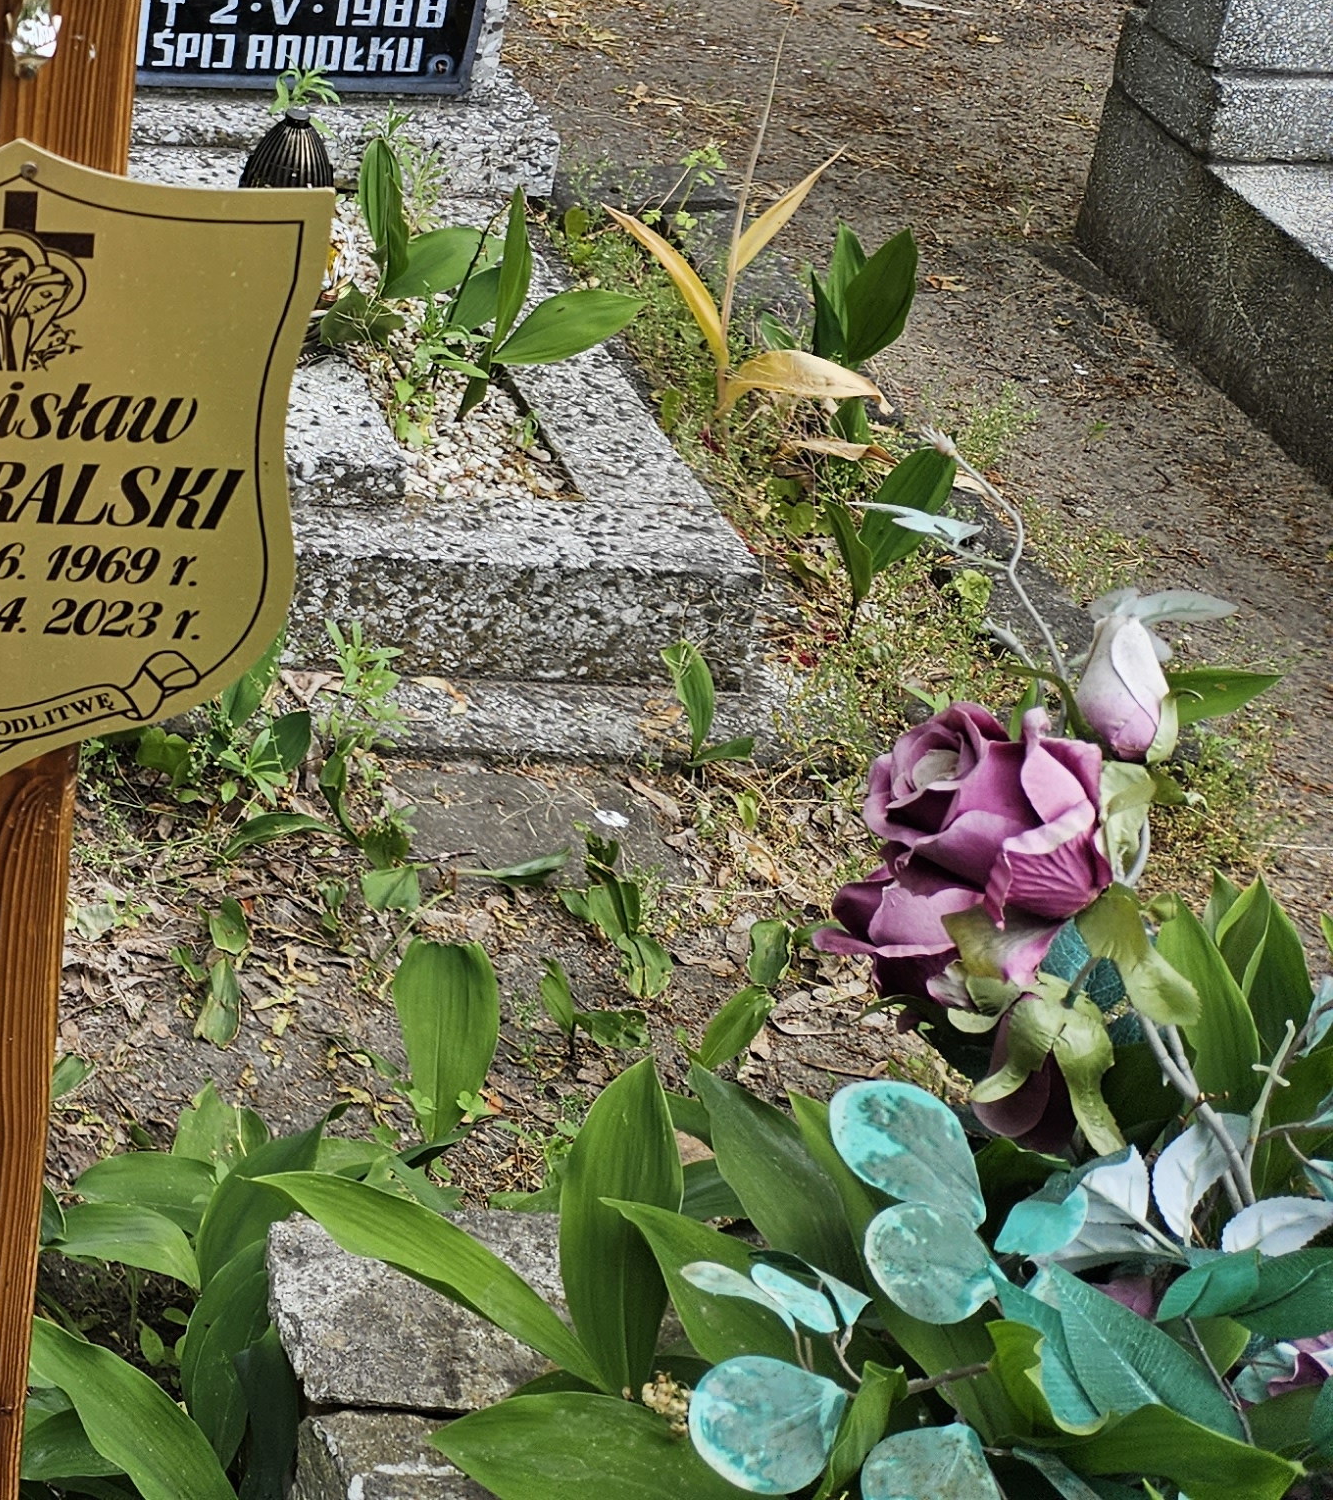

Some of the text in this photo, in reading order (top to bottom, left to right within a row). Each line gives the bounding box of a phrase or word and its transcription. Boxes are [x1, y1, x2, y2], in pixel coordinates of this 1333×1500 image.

[46, 544, 160, 586] 1969
[169, 553, 198, 587] r.
[42, 598, 161, 640] 2023
[171, 607, 201, 641] r.
